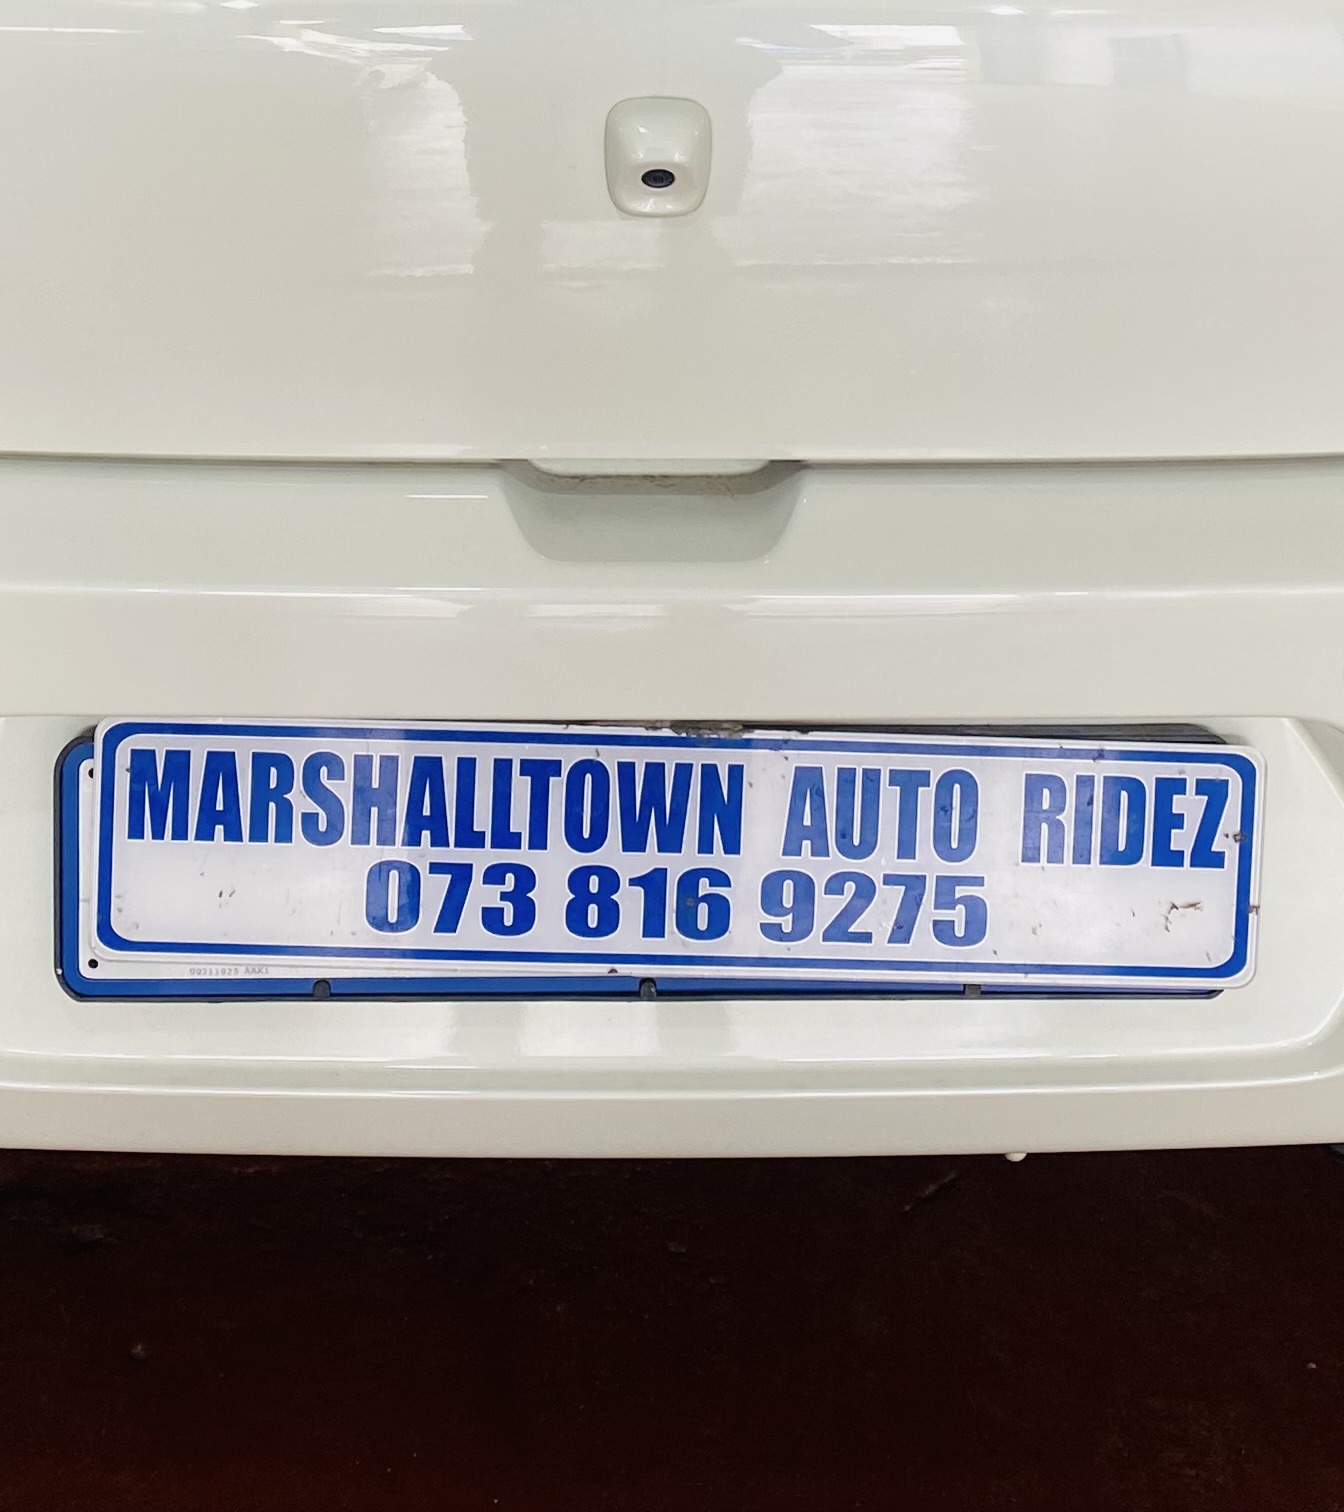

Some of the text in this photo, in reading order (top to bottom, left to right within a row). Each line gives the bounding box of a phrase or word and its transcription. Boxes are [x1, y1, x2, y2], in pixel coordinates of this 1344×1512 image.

[126, 747, 1230, 871] MARSHALLTOWN AUTO RIDEZ
[364, 859, 988, 947] 073 816 9275
